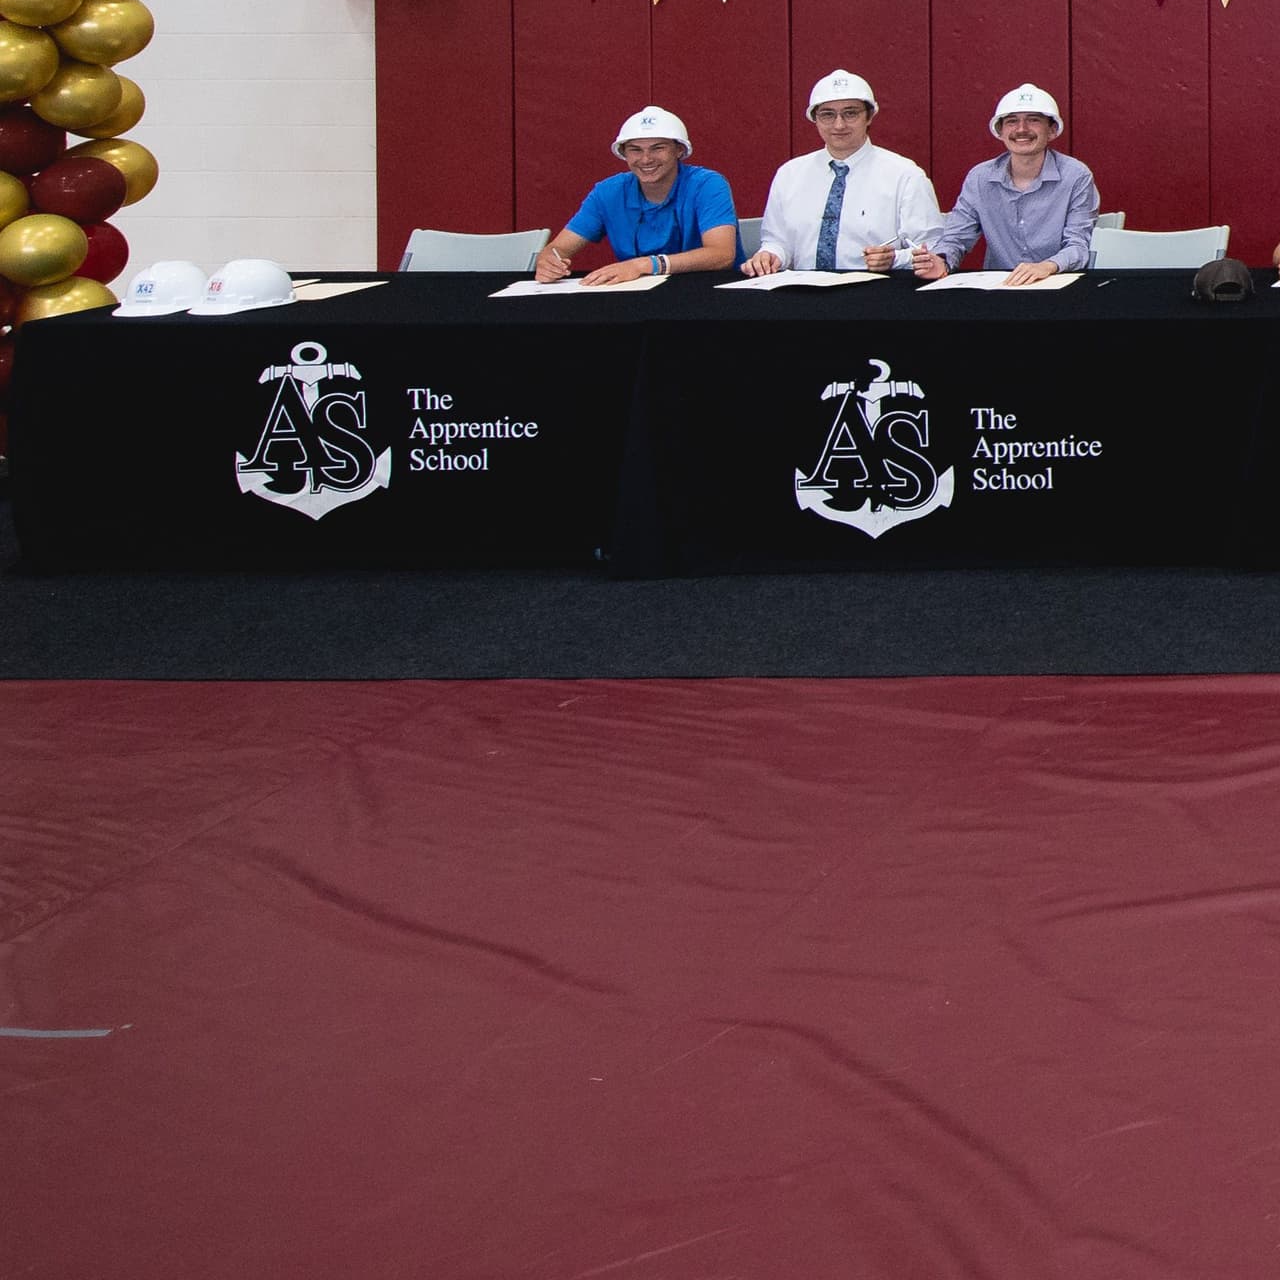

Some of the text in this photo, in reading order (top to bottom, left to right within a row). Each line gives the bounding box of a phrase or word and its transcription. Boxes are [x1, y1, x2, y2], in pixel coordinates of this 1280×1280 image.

[406, 387, 453, 410] The
[408, 415, 539, 446] Apprentice
[970, 407, 1017, 430] The
[238, 372, 377, 494] AS
[409, 447, 489, 471] School
[798, 390, 937, 511] AS
[971, 434, 1103, 465] Apprentice
[972, 466, 1054, 491] School
